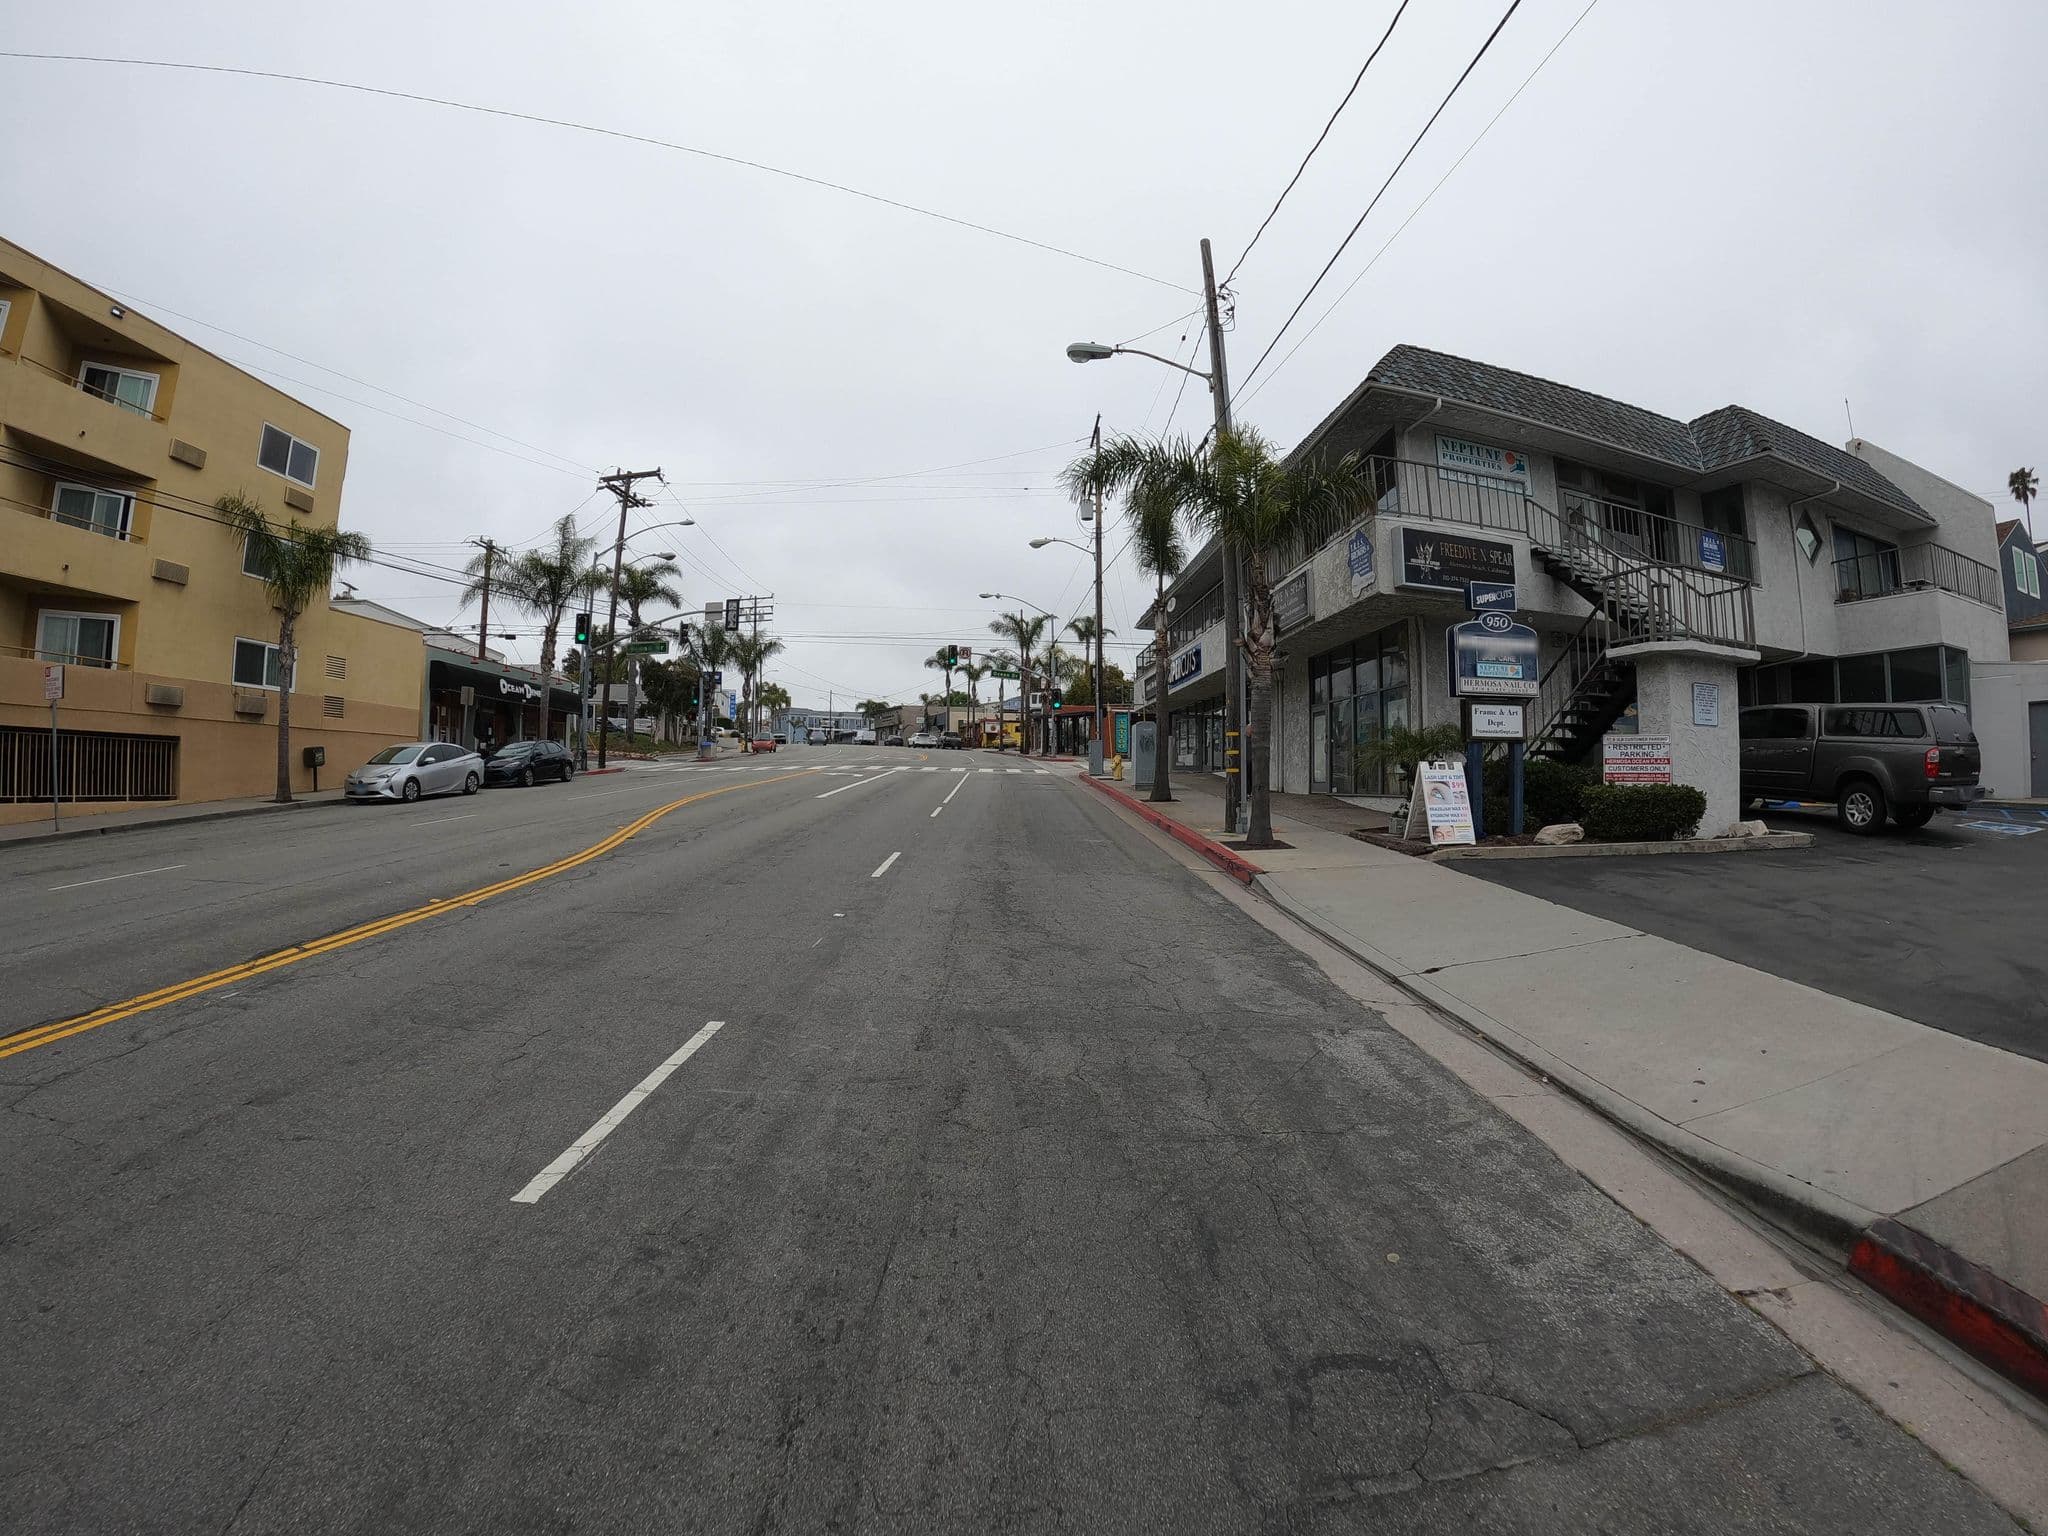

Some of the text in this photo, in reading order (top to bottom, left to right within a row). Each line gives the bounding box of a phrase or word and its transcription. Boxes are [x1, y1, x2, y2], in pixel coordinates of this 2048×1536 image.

[1441, 439, 1502, 461] NEPTUNE
[1442, 452, 1503, 470] PROPERTIES
[1440, 542, 1477, 560] FREEDIVE
[1489, 550, 1513, 567] SPEAR
[1476, 590, 1515, 604] SUPERCUTS
[1486, 616, 1508, 629] 950
[500, 678, 525, 695] OCEAN
[1474, 707, 1518, 716] Frame & Art
[1487, 719, 1506, 728] Dept.
[1613, 743, 1662, 751] RESTRICTED
